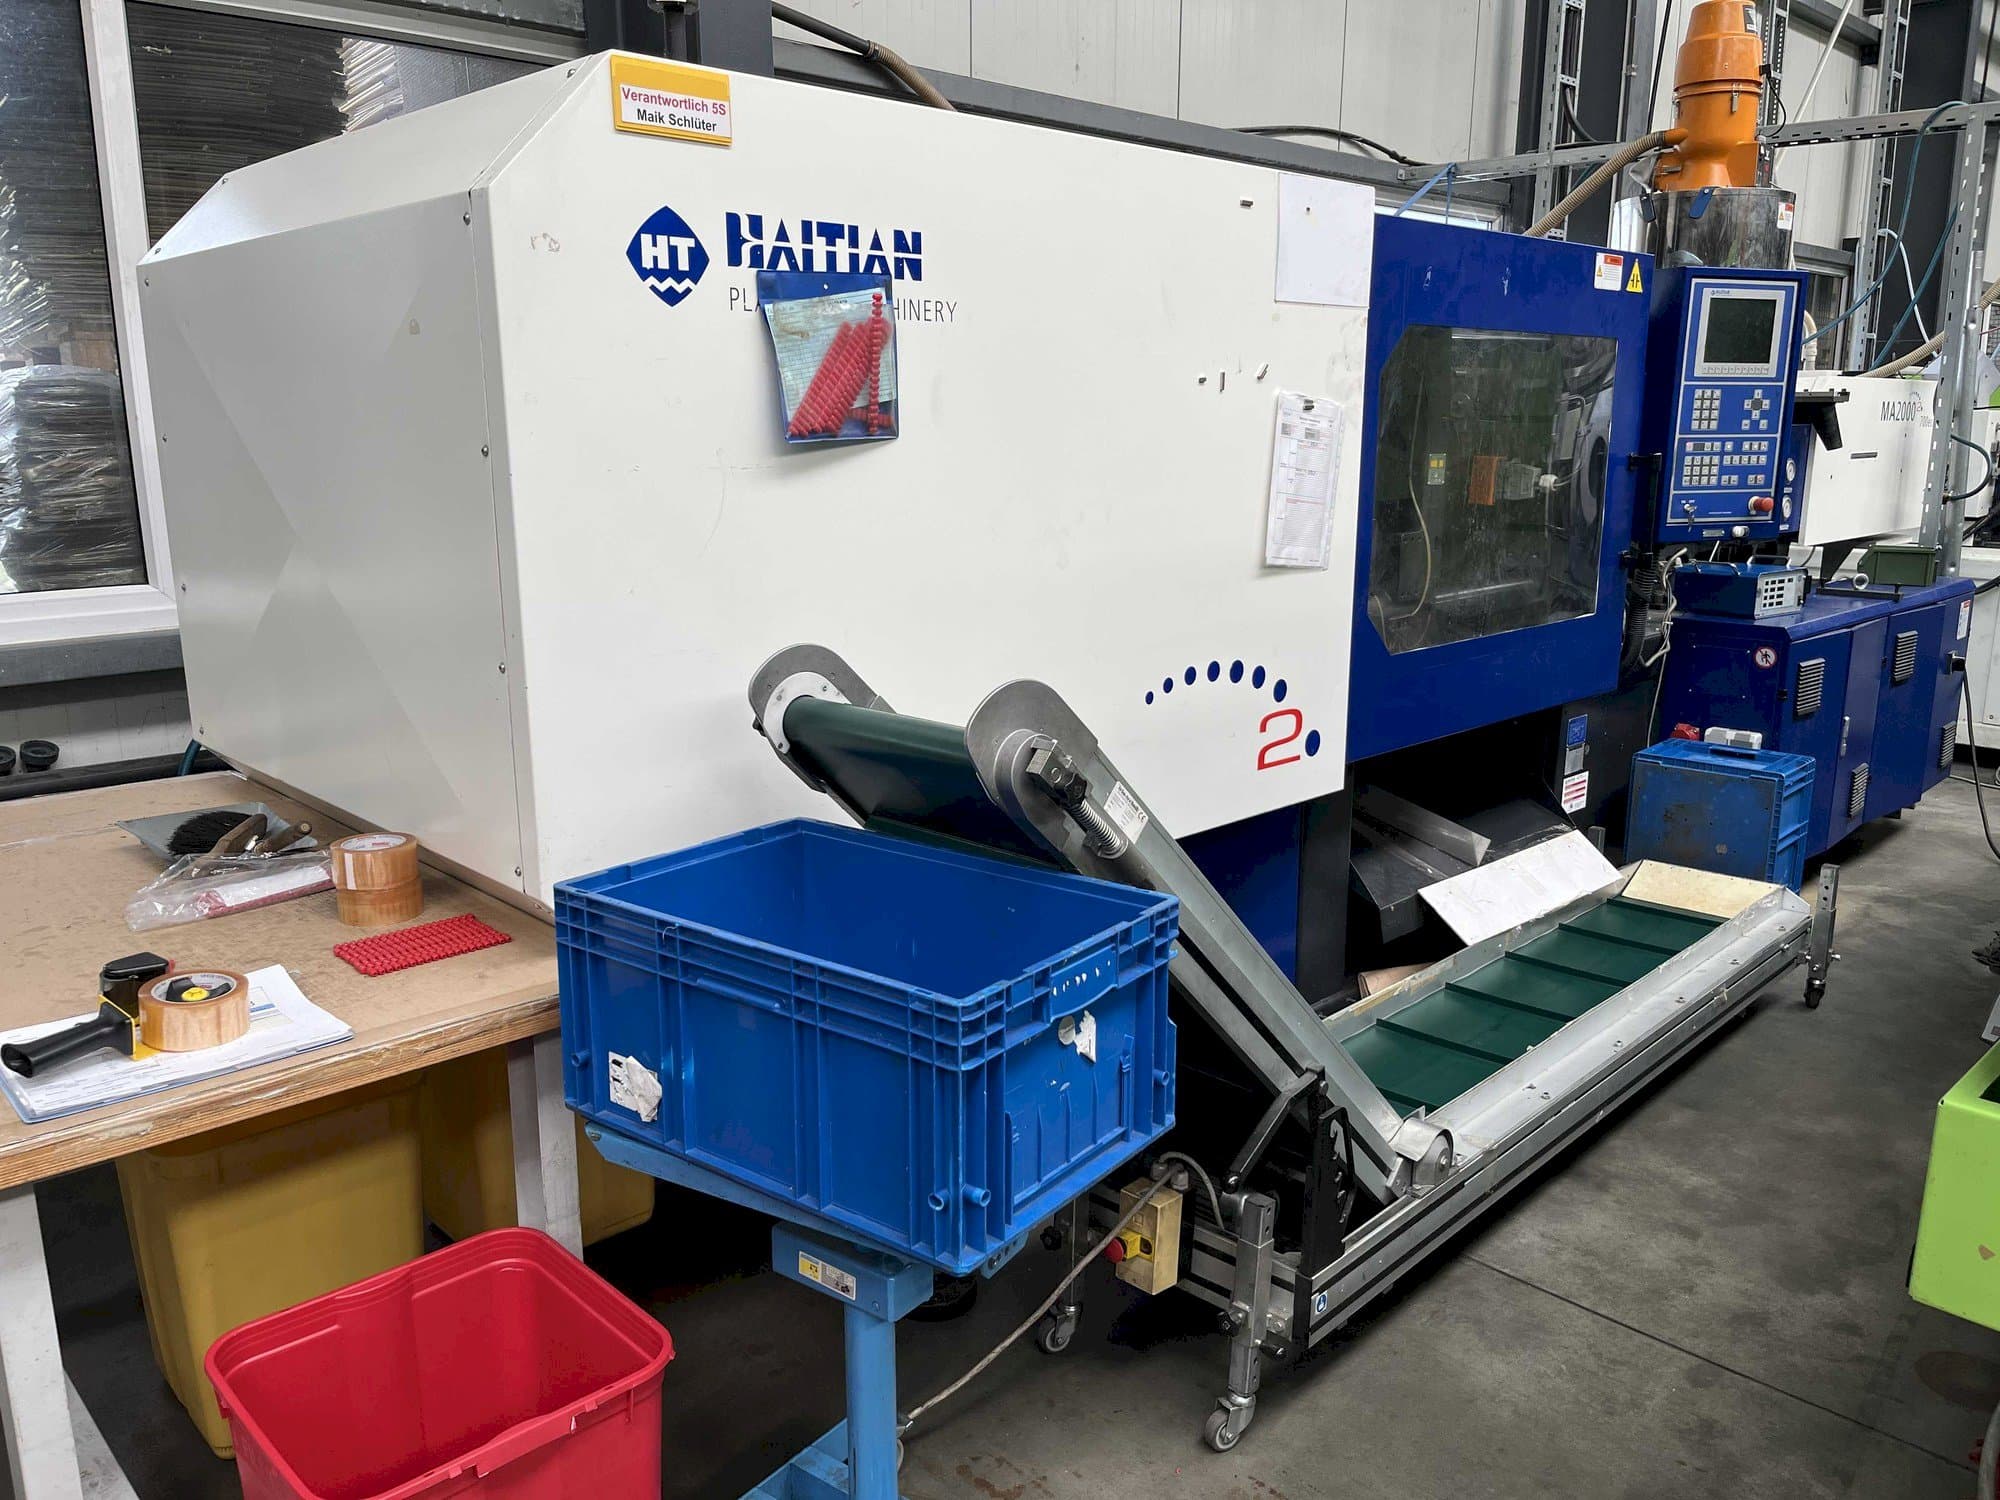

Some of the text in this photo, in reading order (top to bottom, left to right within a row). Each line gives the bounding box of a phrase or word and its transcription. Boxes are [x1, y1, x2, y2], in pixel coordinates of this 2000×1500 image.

[621, 87, 727, 116] Verantwortlich 5S
[636, 108, 717, 132] Maik Schlüter
[640, 232, 695, 272] HT
[725, 211, 922, 282] HAITIAN
[893, 297, 957, 323] HINERY
[1880, 400, 1916, 422] MA2000
